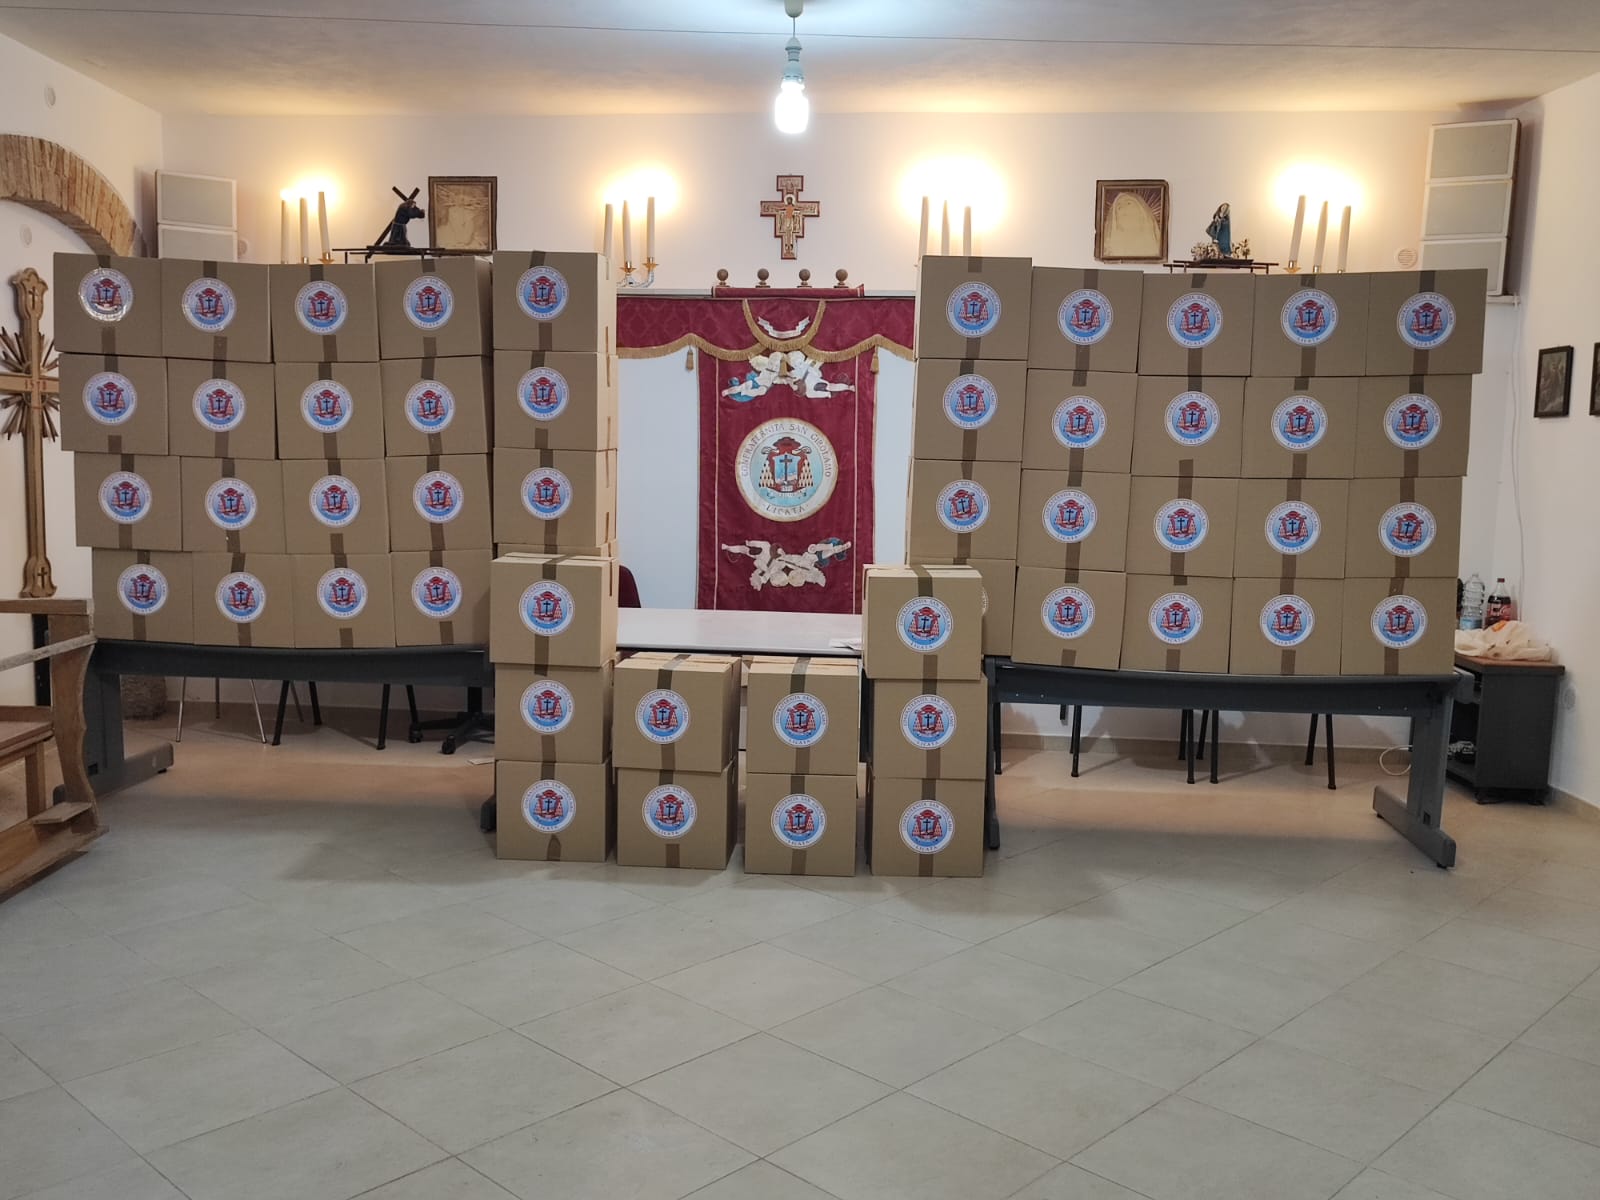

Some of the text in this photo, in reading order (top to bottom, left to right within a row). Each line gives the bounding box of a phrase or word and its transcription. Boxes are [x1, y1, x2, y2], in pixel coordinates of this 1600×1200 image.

[741, 424, 785, 477] CONFRATERNITA
[789, 424, 808, 435] SAN
[766, 504, 805, 516] LICATA
